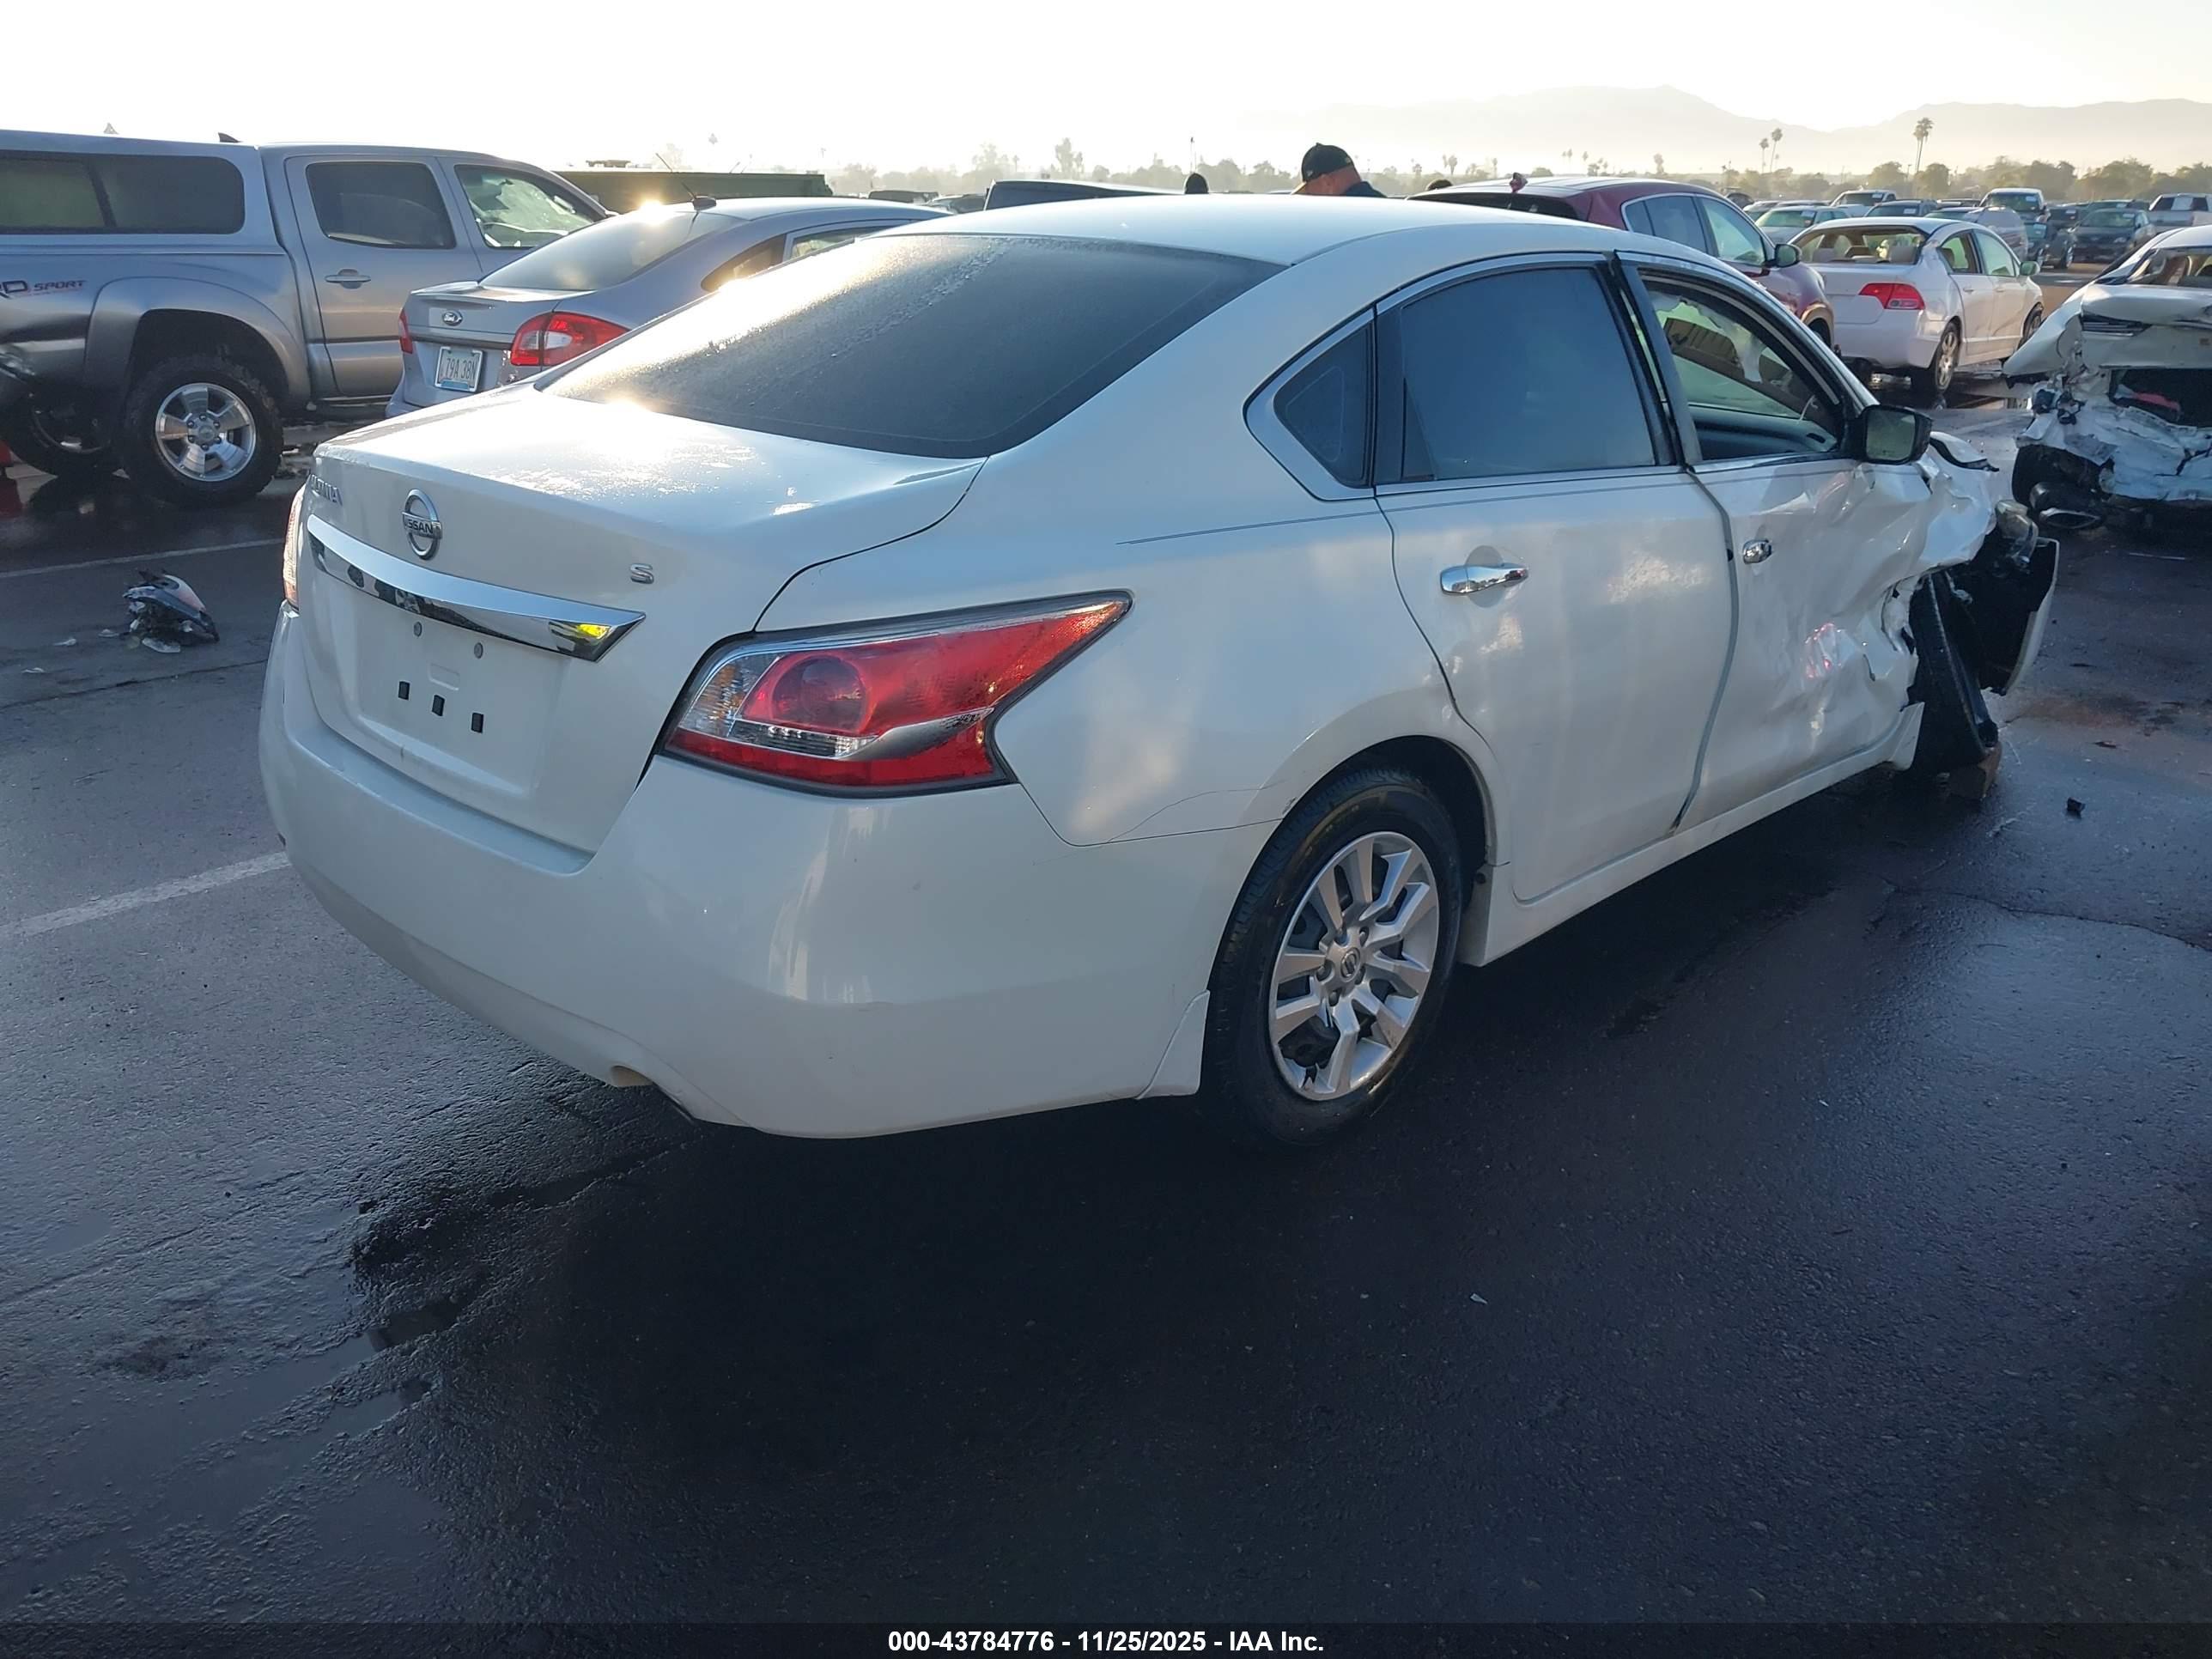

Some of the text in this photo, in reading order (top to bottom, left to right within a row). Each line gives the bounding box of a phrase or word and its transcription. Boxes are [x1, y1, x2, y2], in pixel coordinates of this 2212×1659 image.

[34, 280, 88, 291] SPORT
[404, 518, 434, 534] SSAN
[630, 563, 654, 585] S
